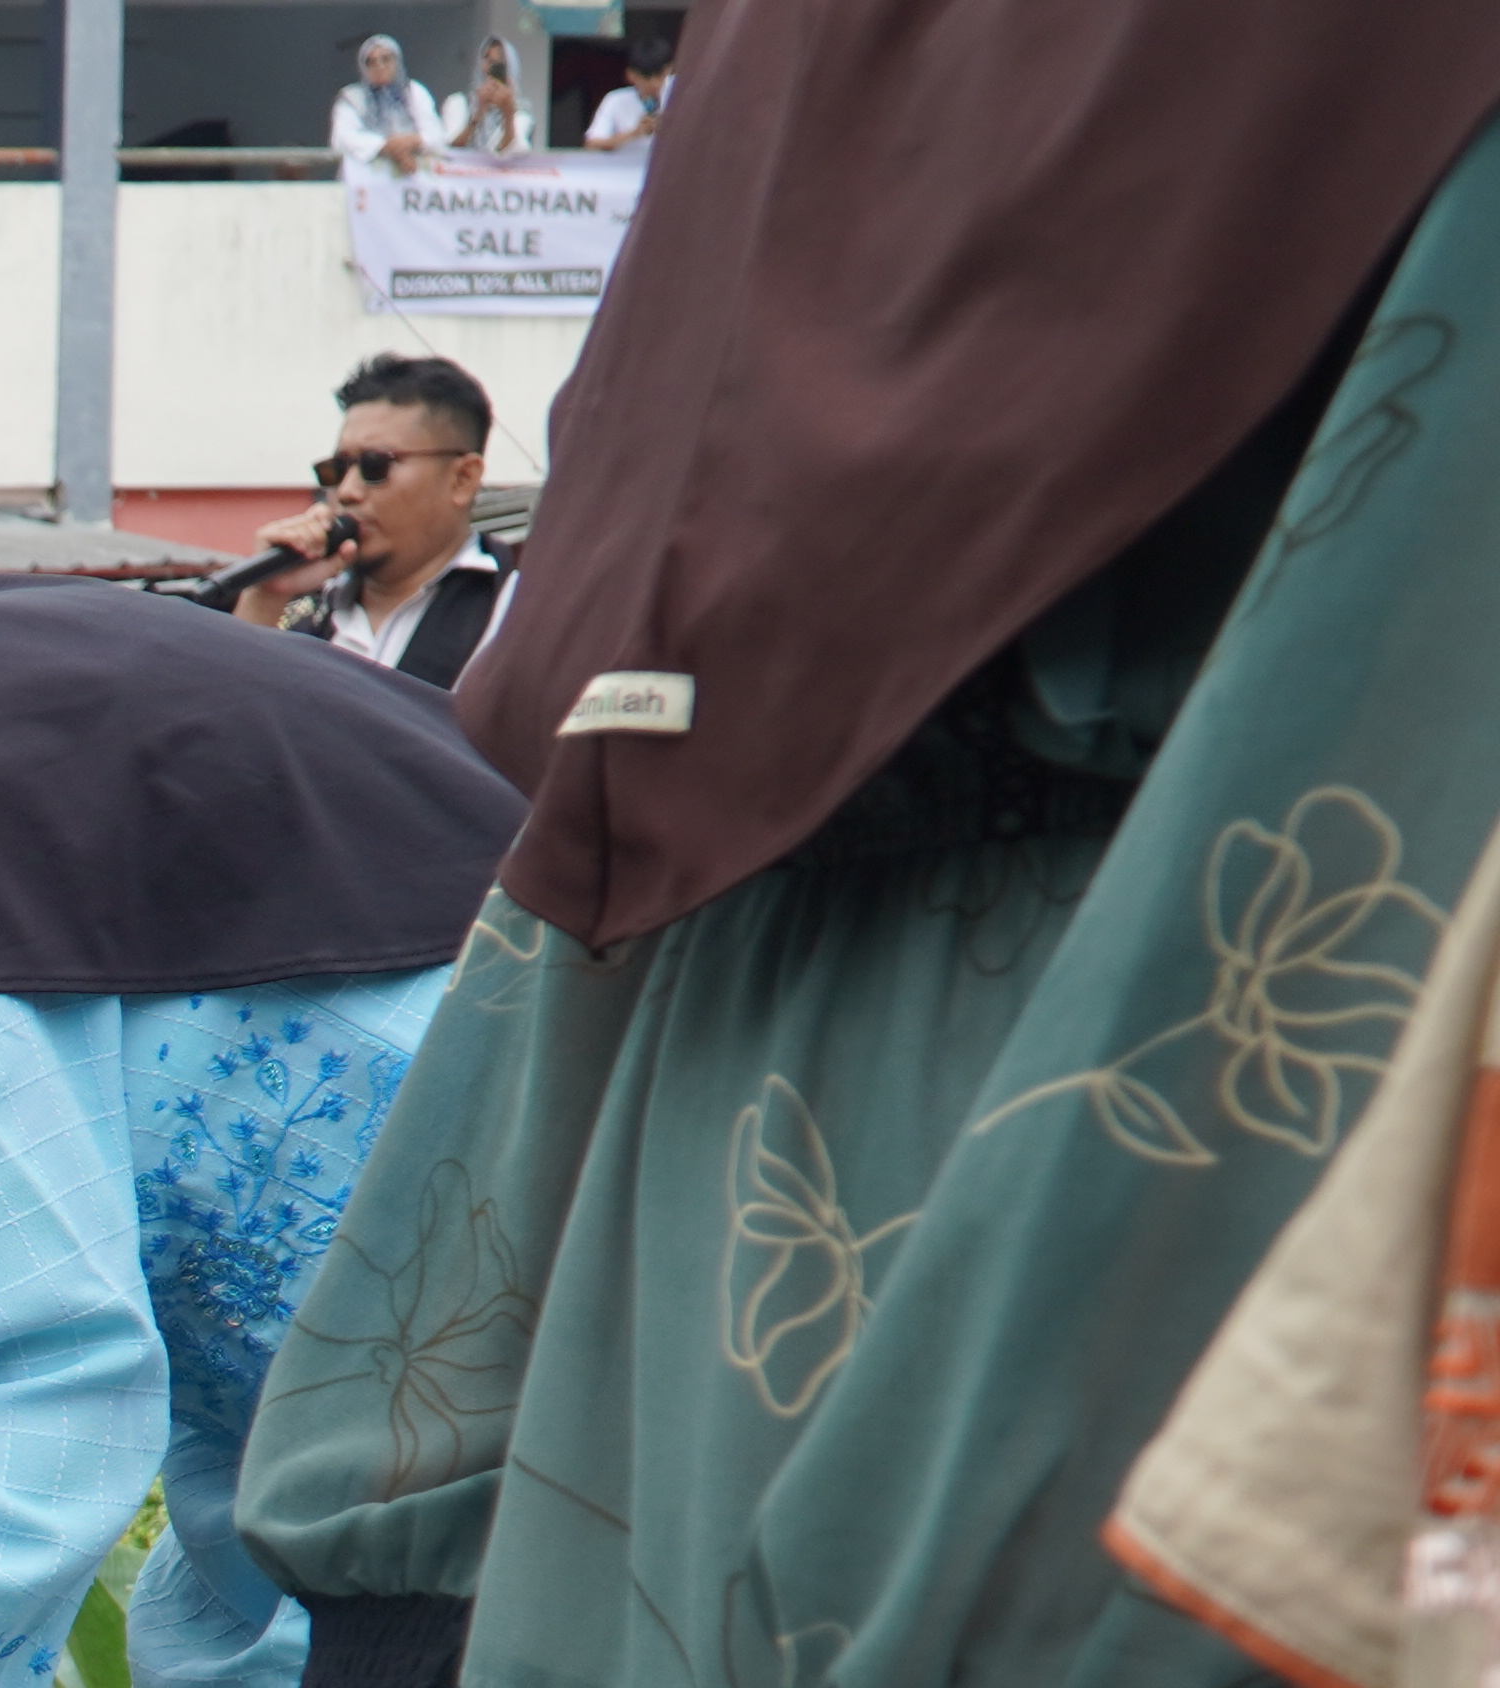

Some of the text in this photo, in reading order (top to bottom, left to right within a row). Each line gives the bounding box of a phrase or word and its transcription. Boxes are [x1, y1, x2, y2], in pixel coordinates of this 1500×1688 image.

[403, 189, 598, 215] RAMADHAN
[456, 229, 542, 257] SALE
[512, 272, 549, 293] ALL
[551, 270, 599, 293] ITEM
